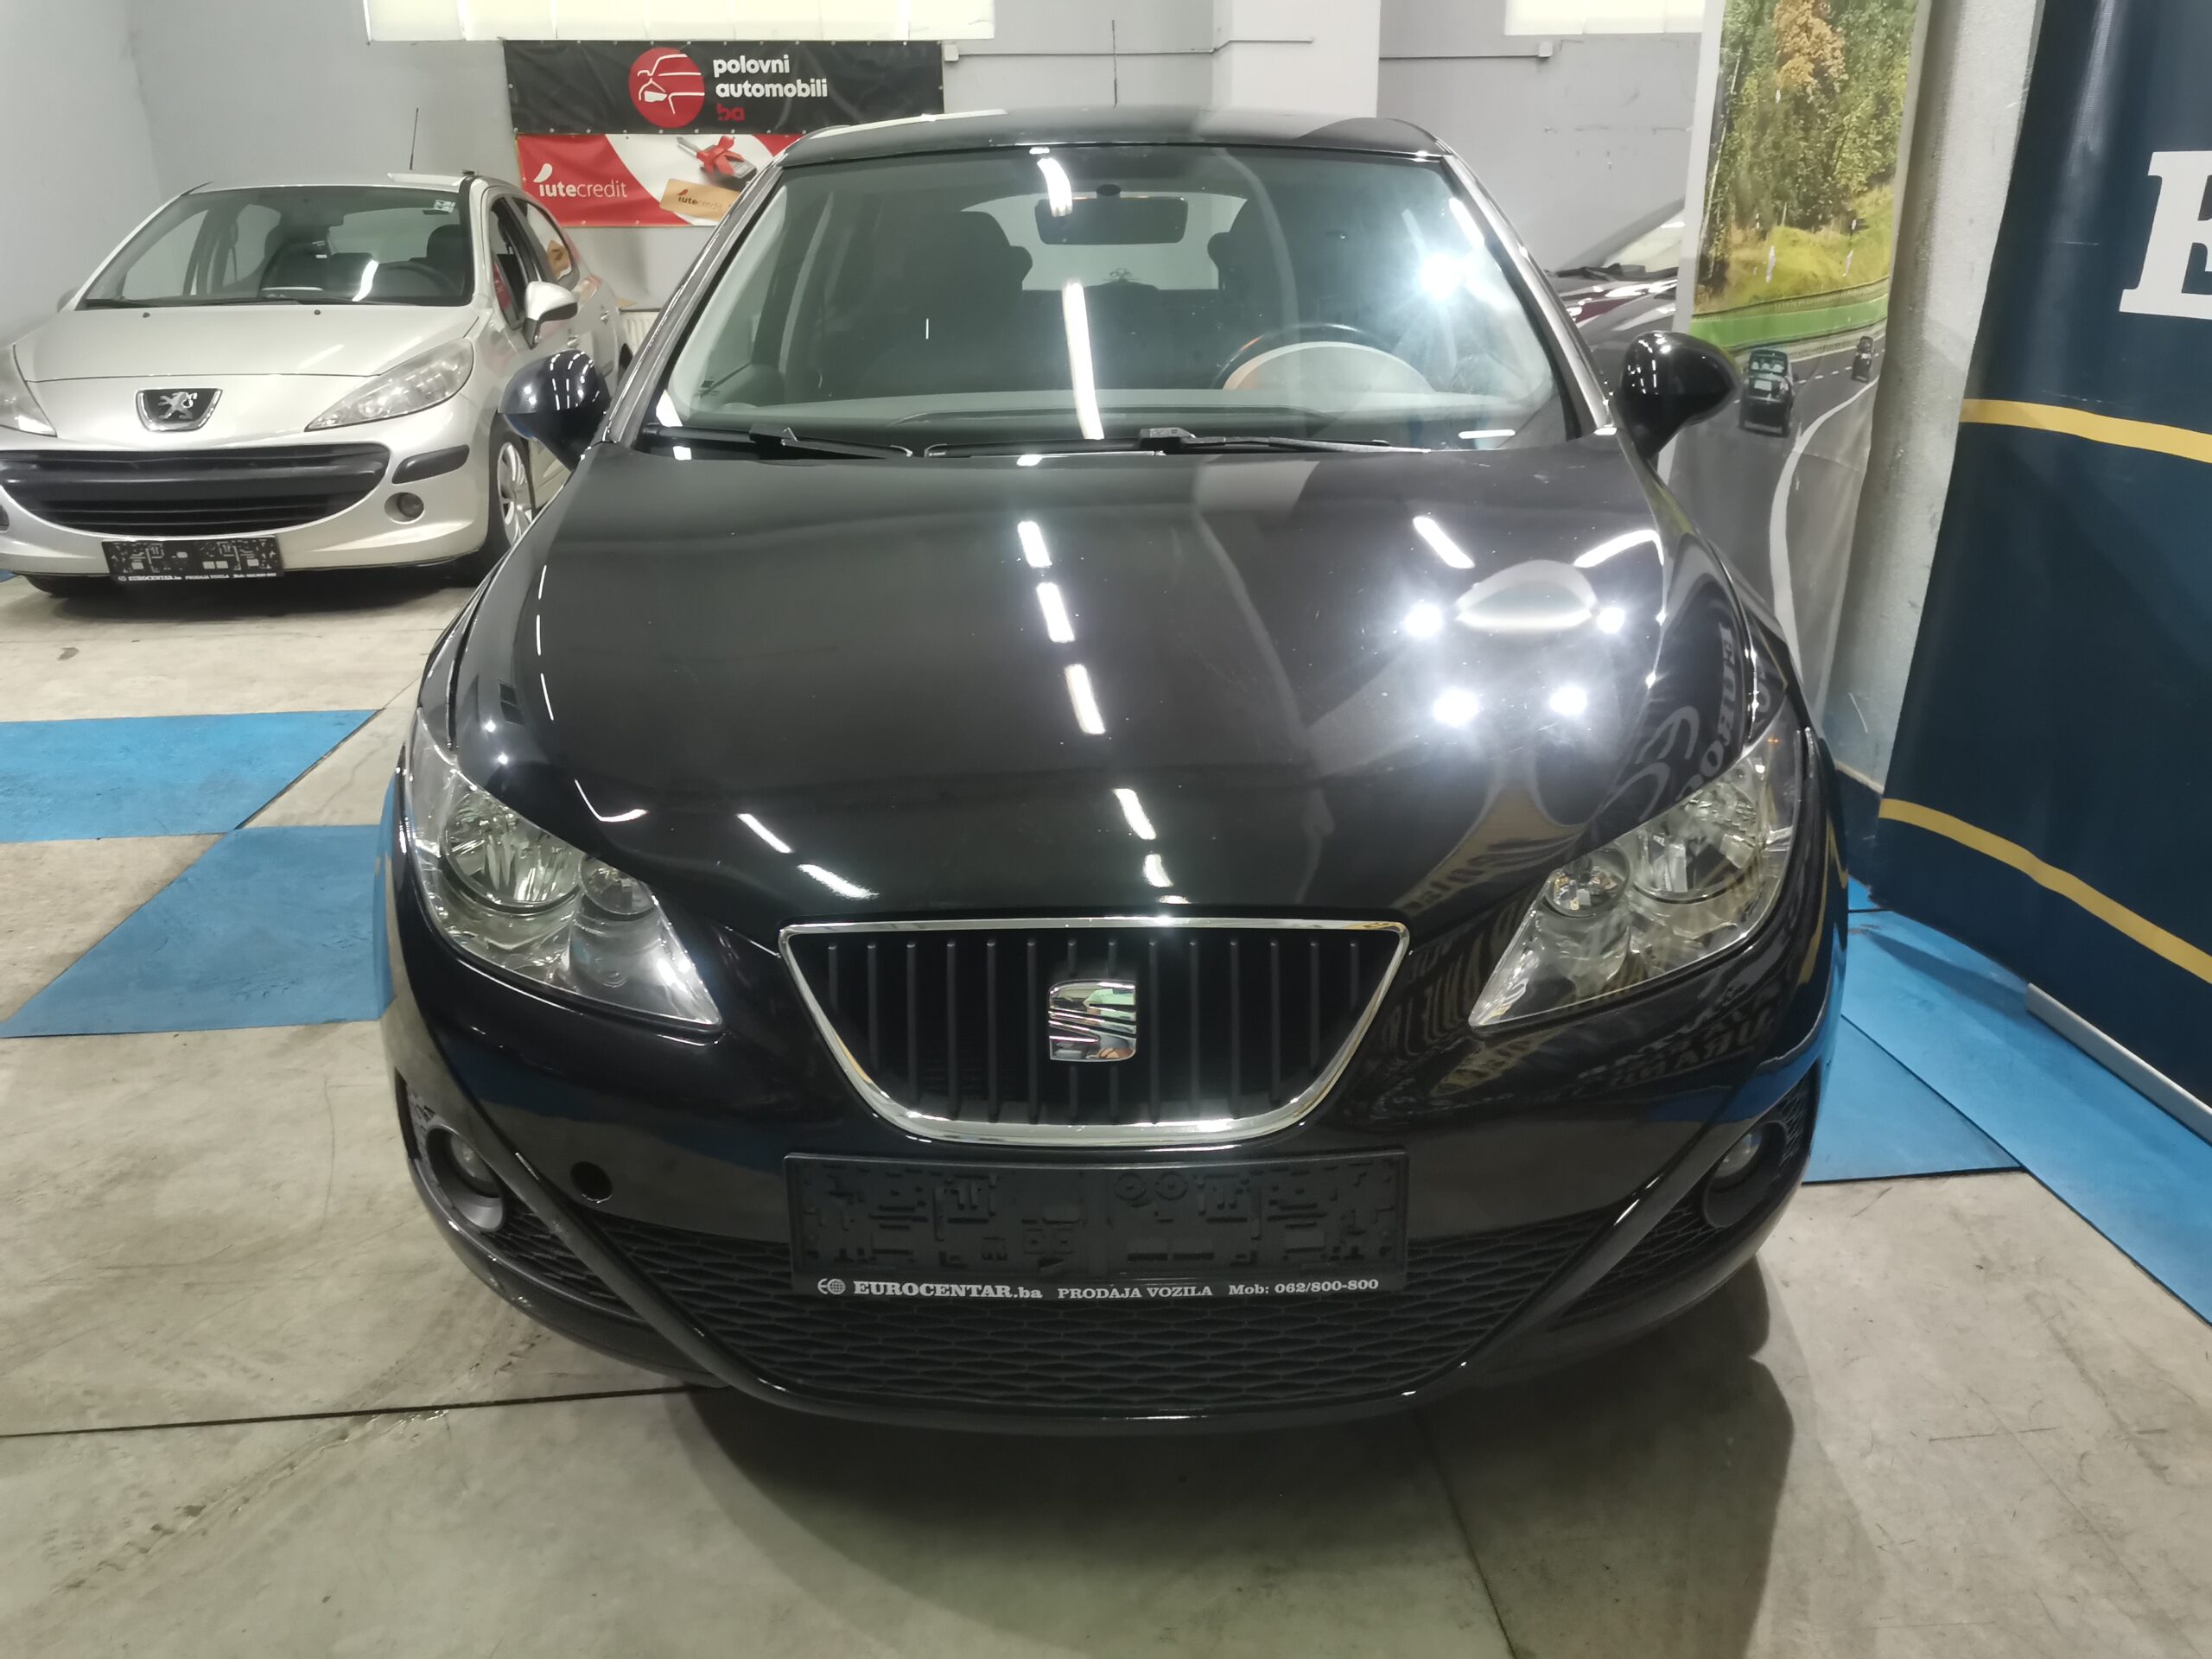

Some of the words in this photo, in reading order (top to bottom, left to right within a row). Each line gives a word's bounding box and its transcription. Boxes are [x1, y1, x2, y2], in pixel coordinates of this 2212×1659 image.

[713, 54, 790, 78] polovni
[715, 78, 828, 98] automobili
[539, 179, 628, 198] iutecredit
[854, 1281, 1043, 1299] EUROCENTAR.ba
[1058, 1287, 1142, 1299] PRODAJA
[1147, 1286, 1212, 1297] VOZILA
[1229, 1284, 1269, 1295] Mob:
[1274, 1279, 1379, 1294] 062/800-800
